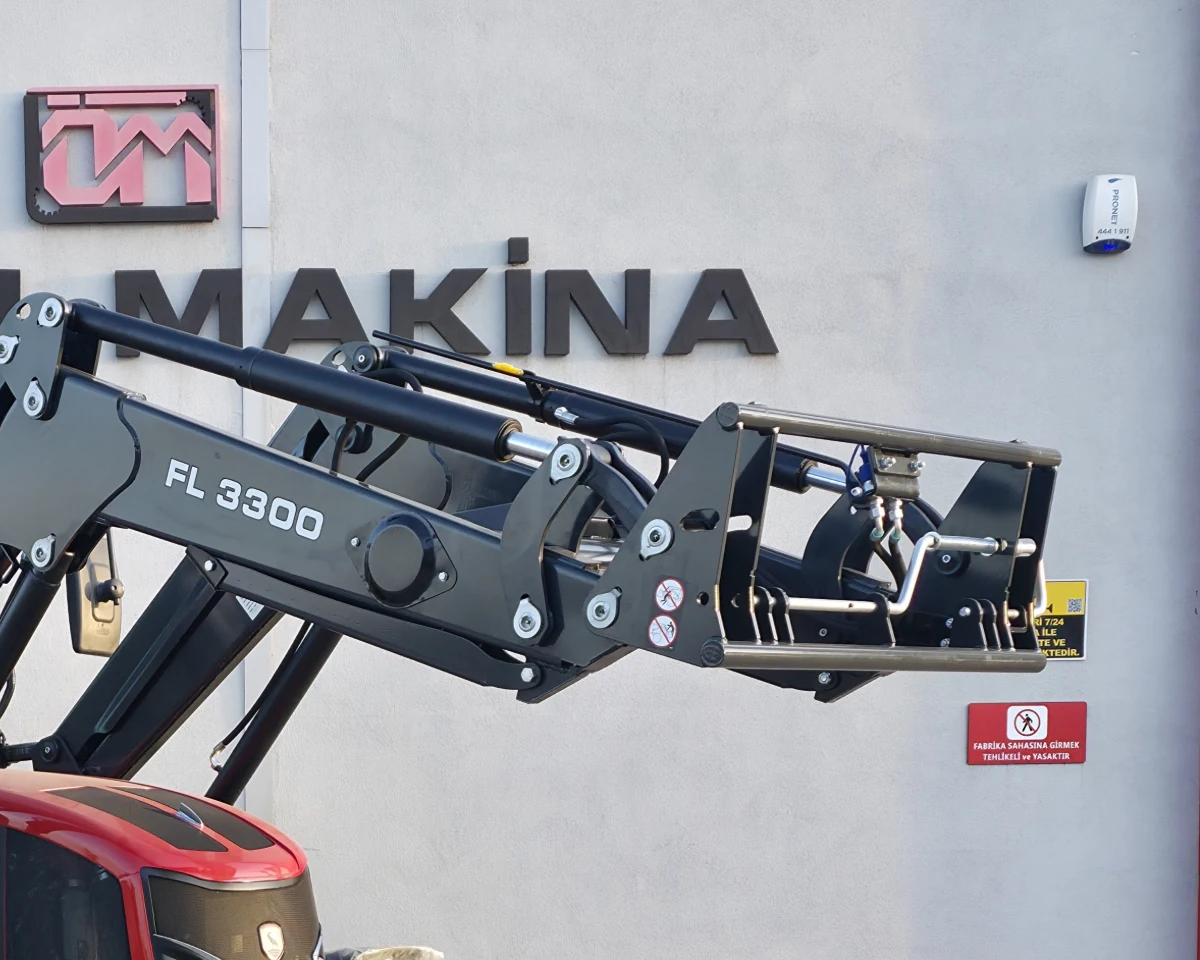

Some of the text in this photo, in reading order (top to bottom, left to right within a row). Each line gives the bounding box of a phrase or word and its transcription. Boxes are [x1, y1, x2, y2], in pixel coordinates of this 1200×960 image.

[1111, 189, 1120, 226] PRONET
[114, 236, 780, 357] MAKİNA
[164, 457, 325, 541] FL 3300
[1044, 618, 1065, 627] 7/24
[1042, 627, 1058, 637] İLE
[1052, 638, 1067, 647] VE
[973, 740, 1080, 750] FABRİKA SAHASINA GİRMEK
[983, 752, 1021, 761] TEHLİKELİ
[1032, 752, 1070, 760] YASAKTIR
